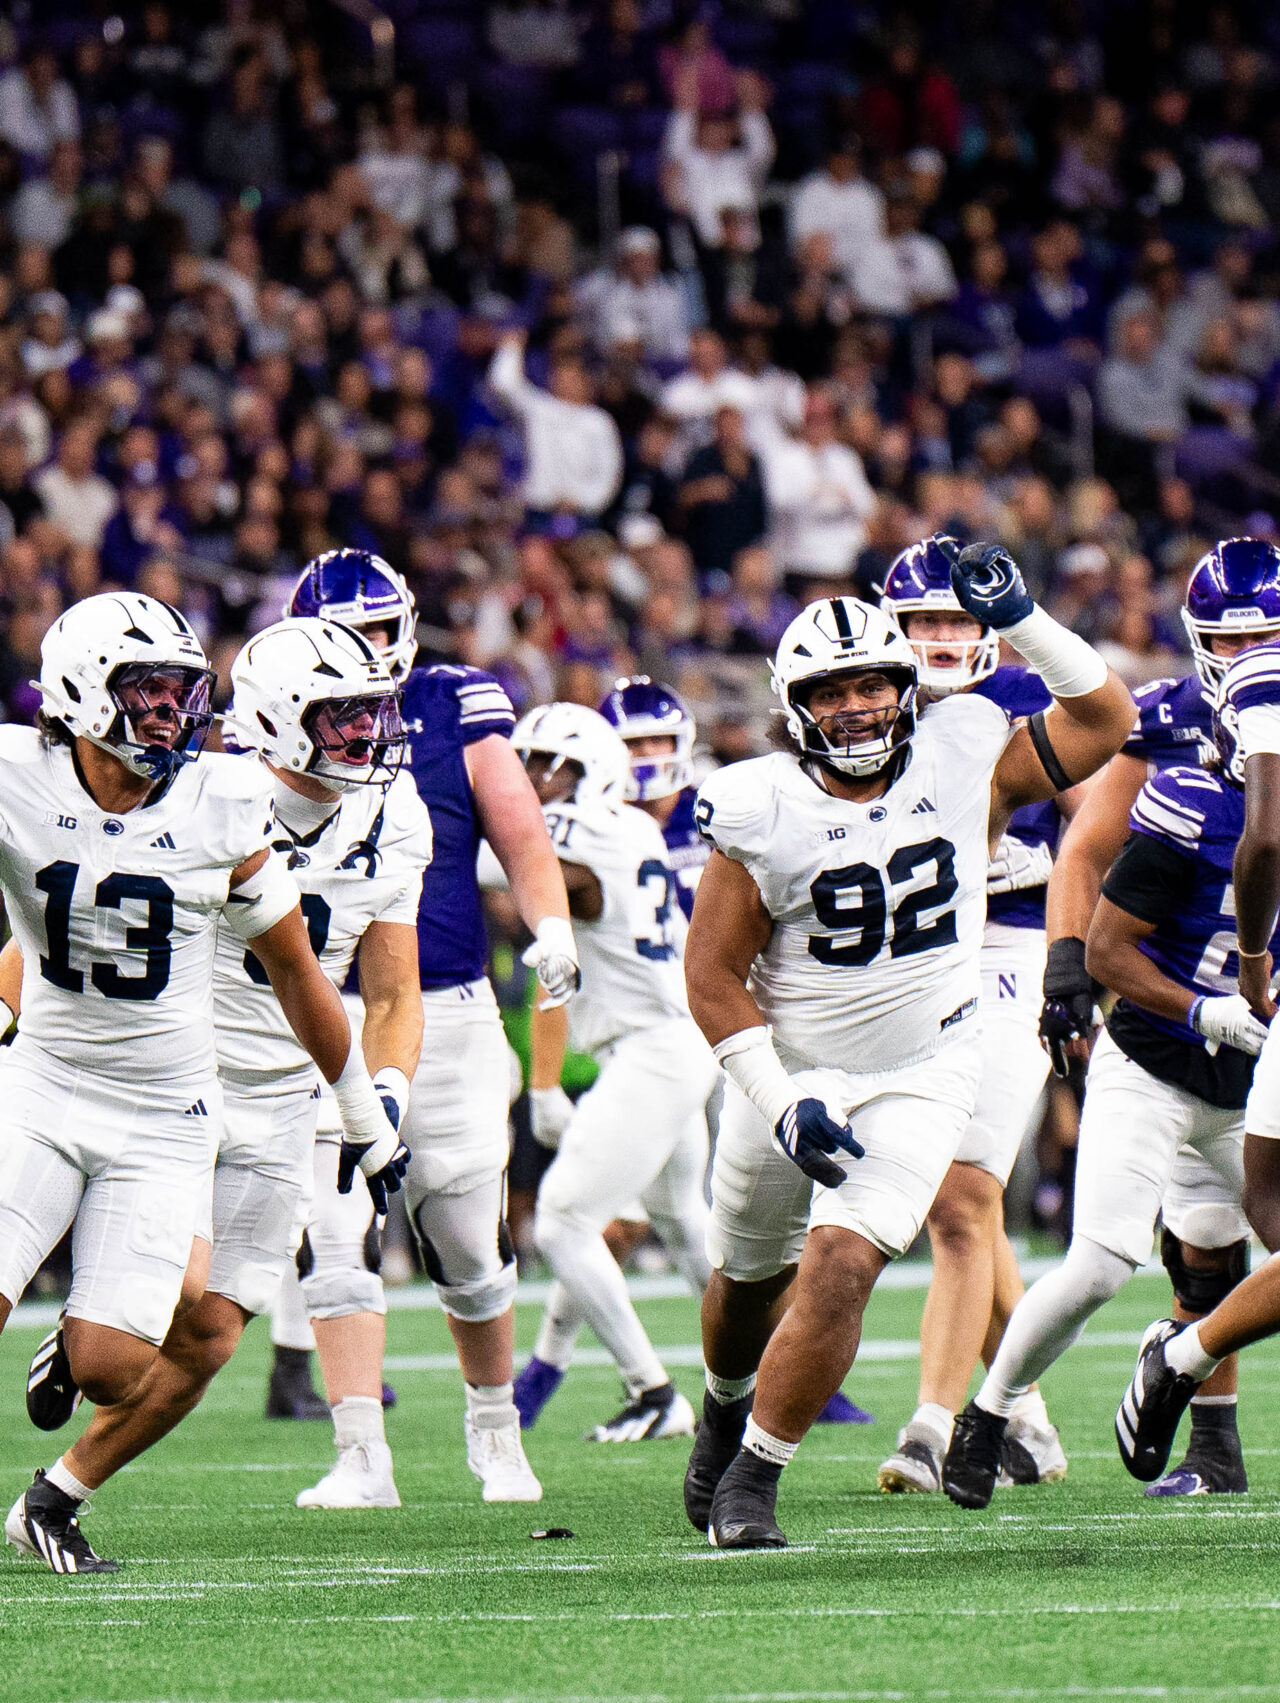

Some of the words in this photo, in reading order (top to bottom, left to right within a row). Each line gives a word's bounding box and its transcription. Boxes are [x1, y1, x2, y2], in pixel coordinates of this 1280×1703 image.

[1158, 703, 1173, 723] C
[35, 860, 175, 1001] 13
[807, 836, 959, 967] 92
[998, 973, 1017, 999] N
